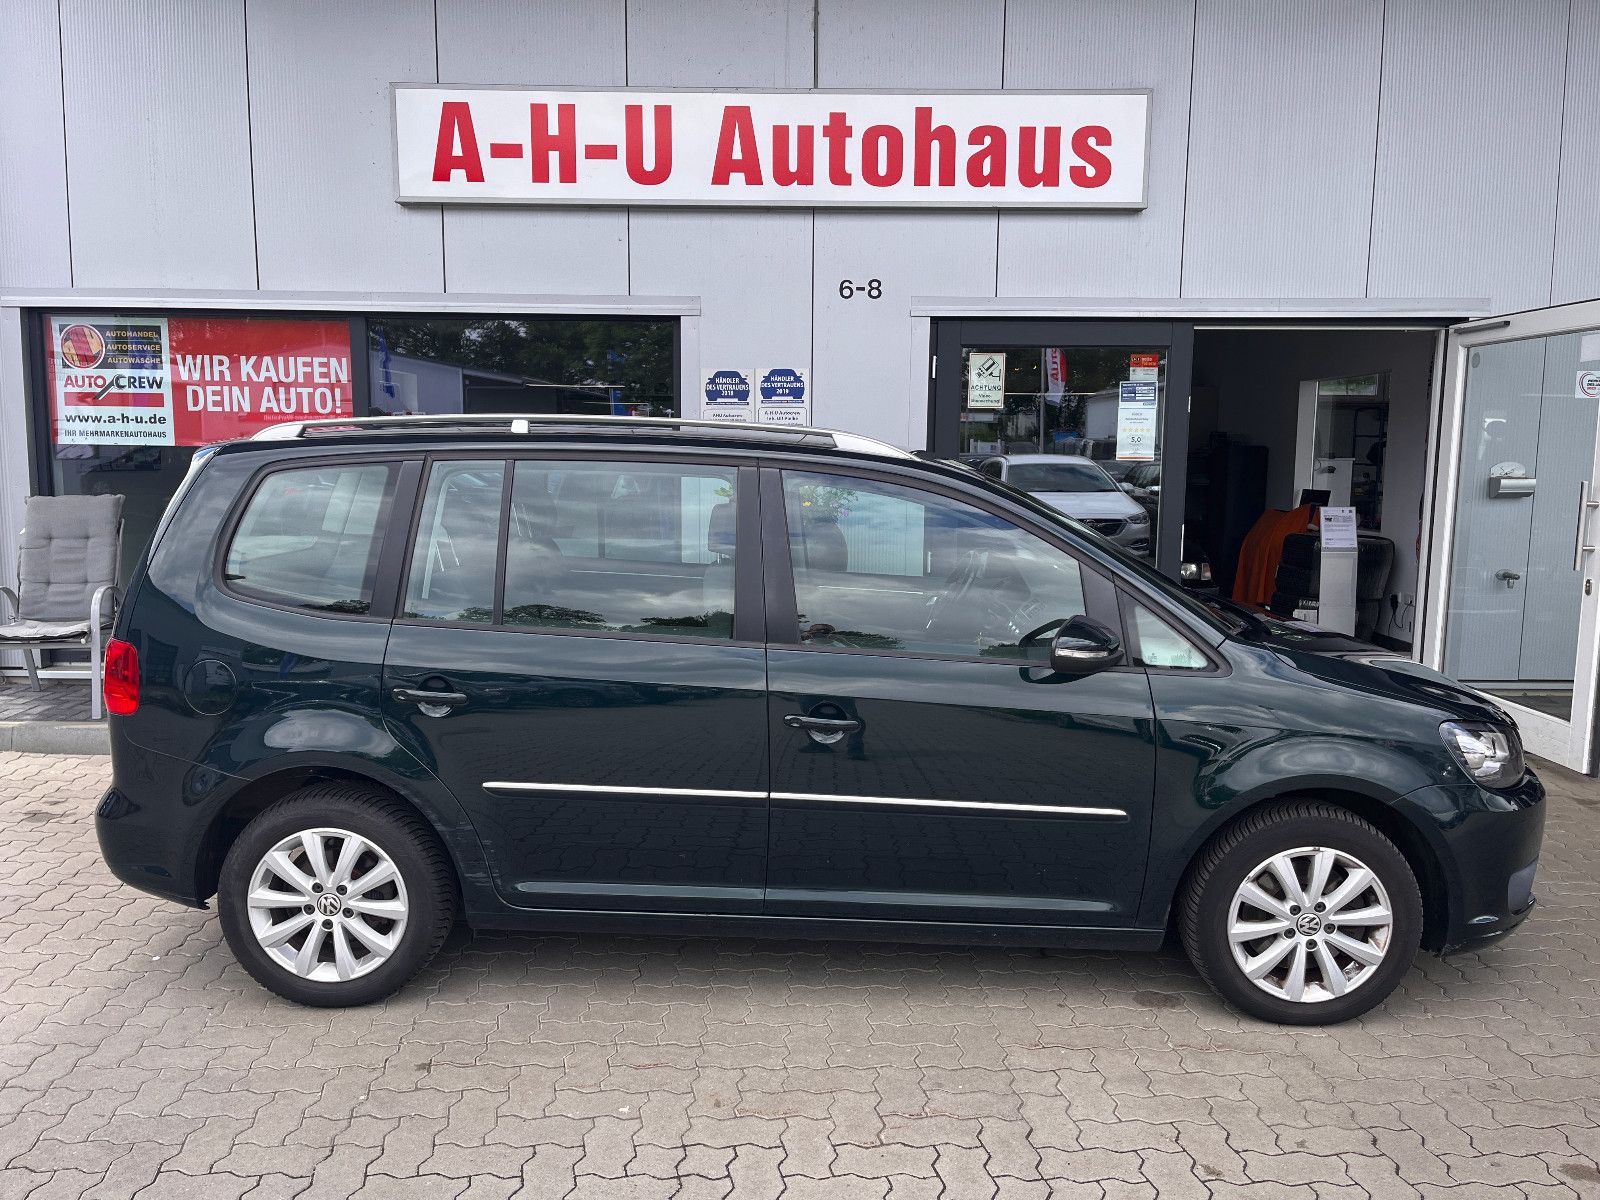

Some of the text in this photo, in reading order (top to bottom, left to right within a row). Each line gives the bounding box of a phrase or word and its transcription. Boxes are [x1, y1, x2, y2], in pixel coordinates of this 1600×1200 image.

[432, 101, 1113, 188] A-H-U Autohaus
[838, 279, 883, 301] 6-8
[105, 330, 159, 338] AUTOHANDEL
[106, 343, 161, 351] AUTOSERVICE
[176, 354, 348, 384] WIR KAUFEN
[114, 375, 164, 389] CREW
[715, 376, 740, 384] HÄNDLER
[187, 385, 342, 414] DEIN AUTO!
[64, 413, 167, 425] www.a-h-u.de
[79, 430, 167, 438] MEHRMARKENAUTOHAUS
